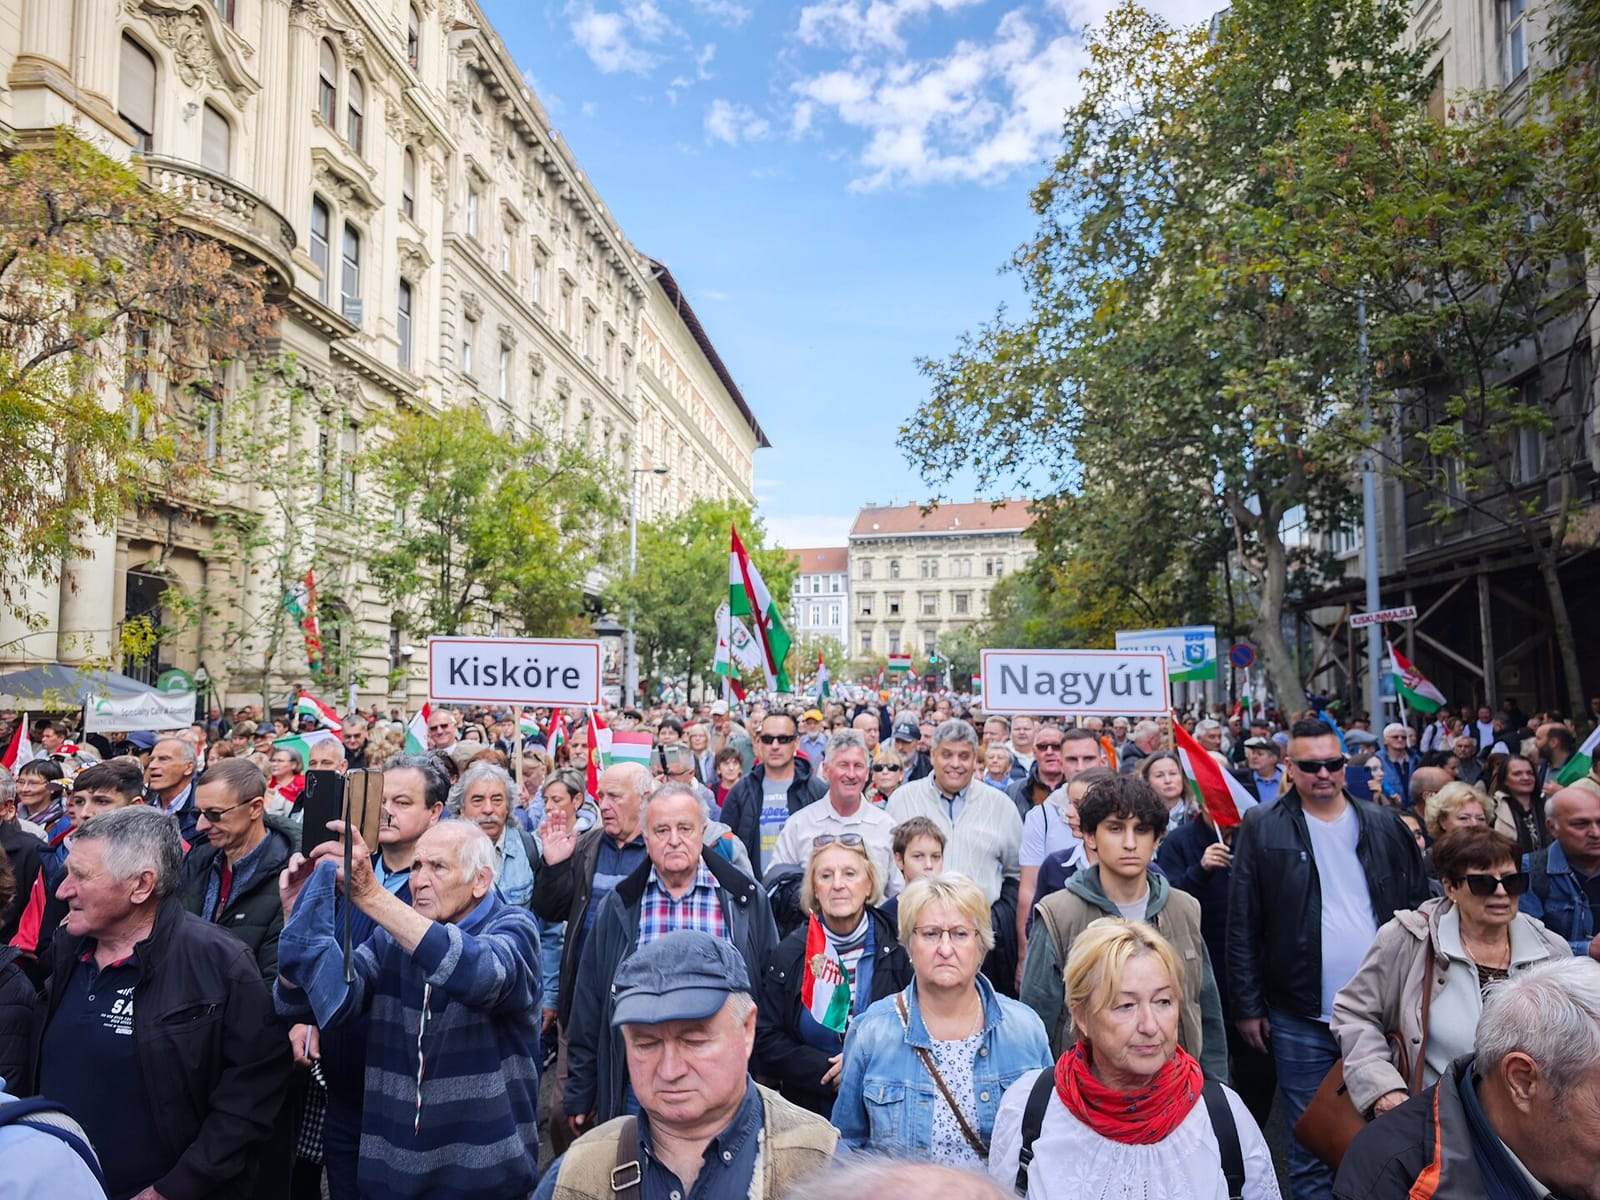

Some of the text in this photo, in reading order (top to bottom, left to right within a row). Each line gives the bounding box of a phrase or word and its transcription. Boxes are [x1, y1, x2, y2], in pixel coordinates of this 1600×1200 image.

[1353, 608, 1414, 624] KISKUNMAJSA
[449, 656, 580, 689] Kisköre
[1000, 663, 1153, 705] Nagyút
